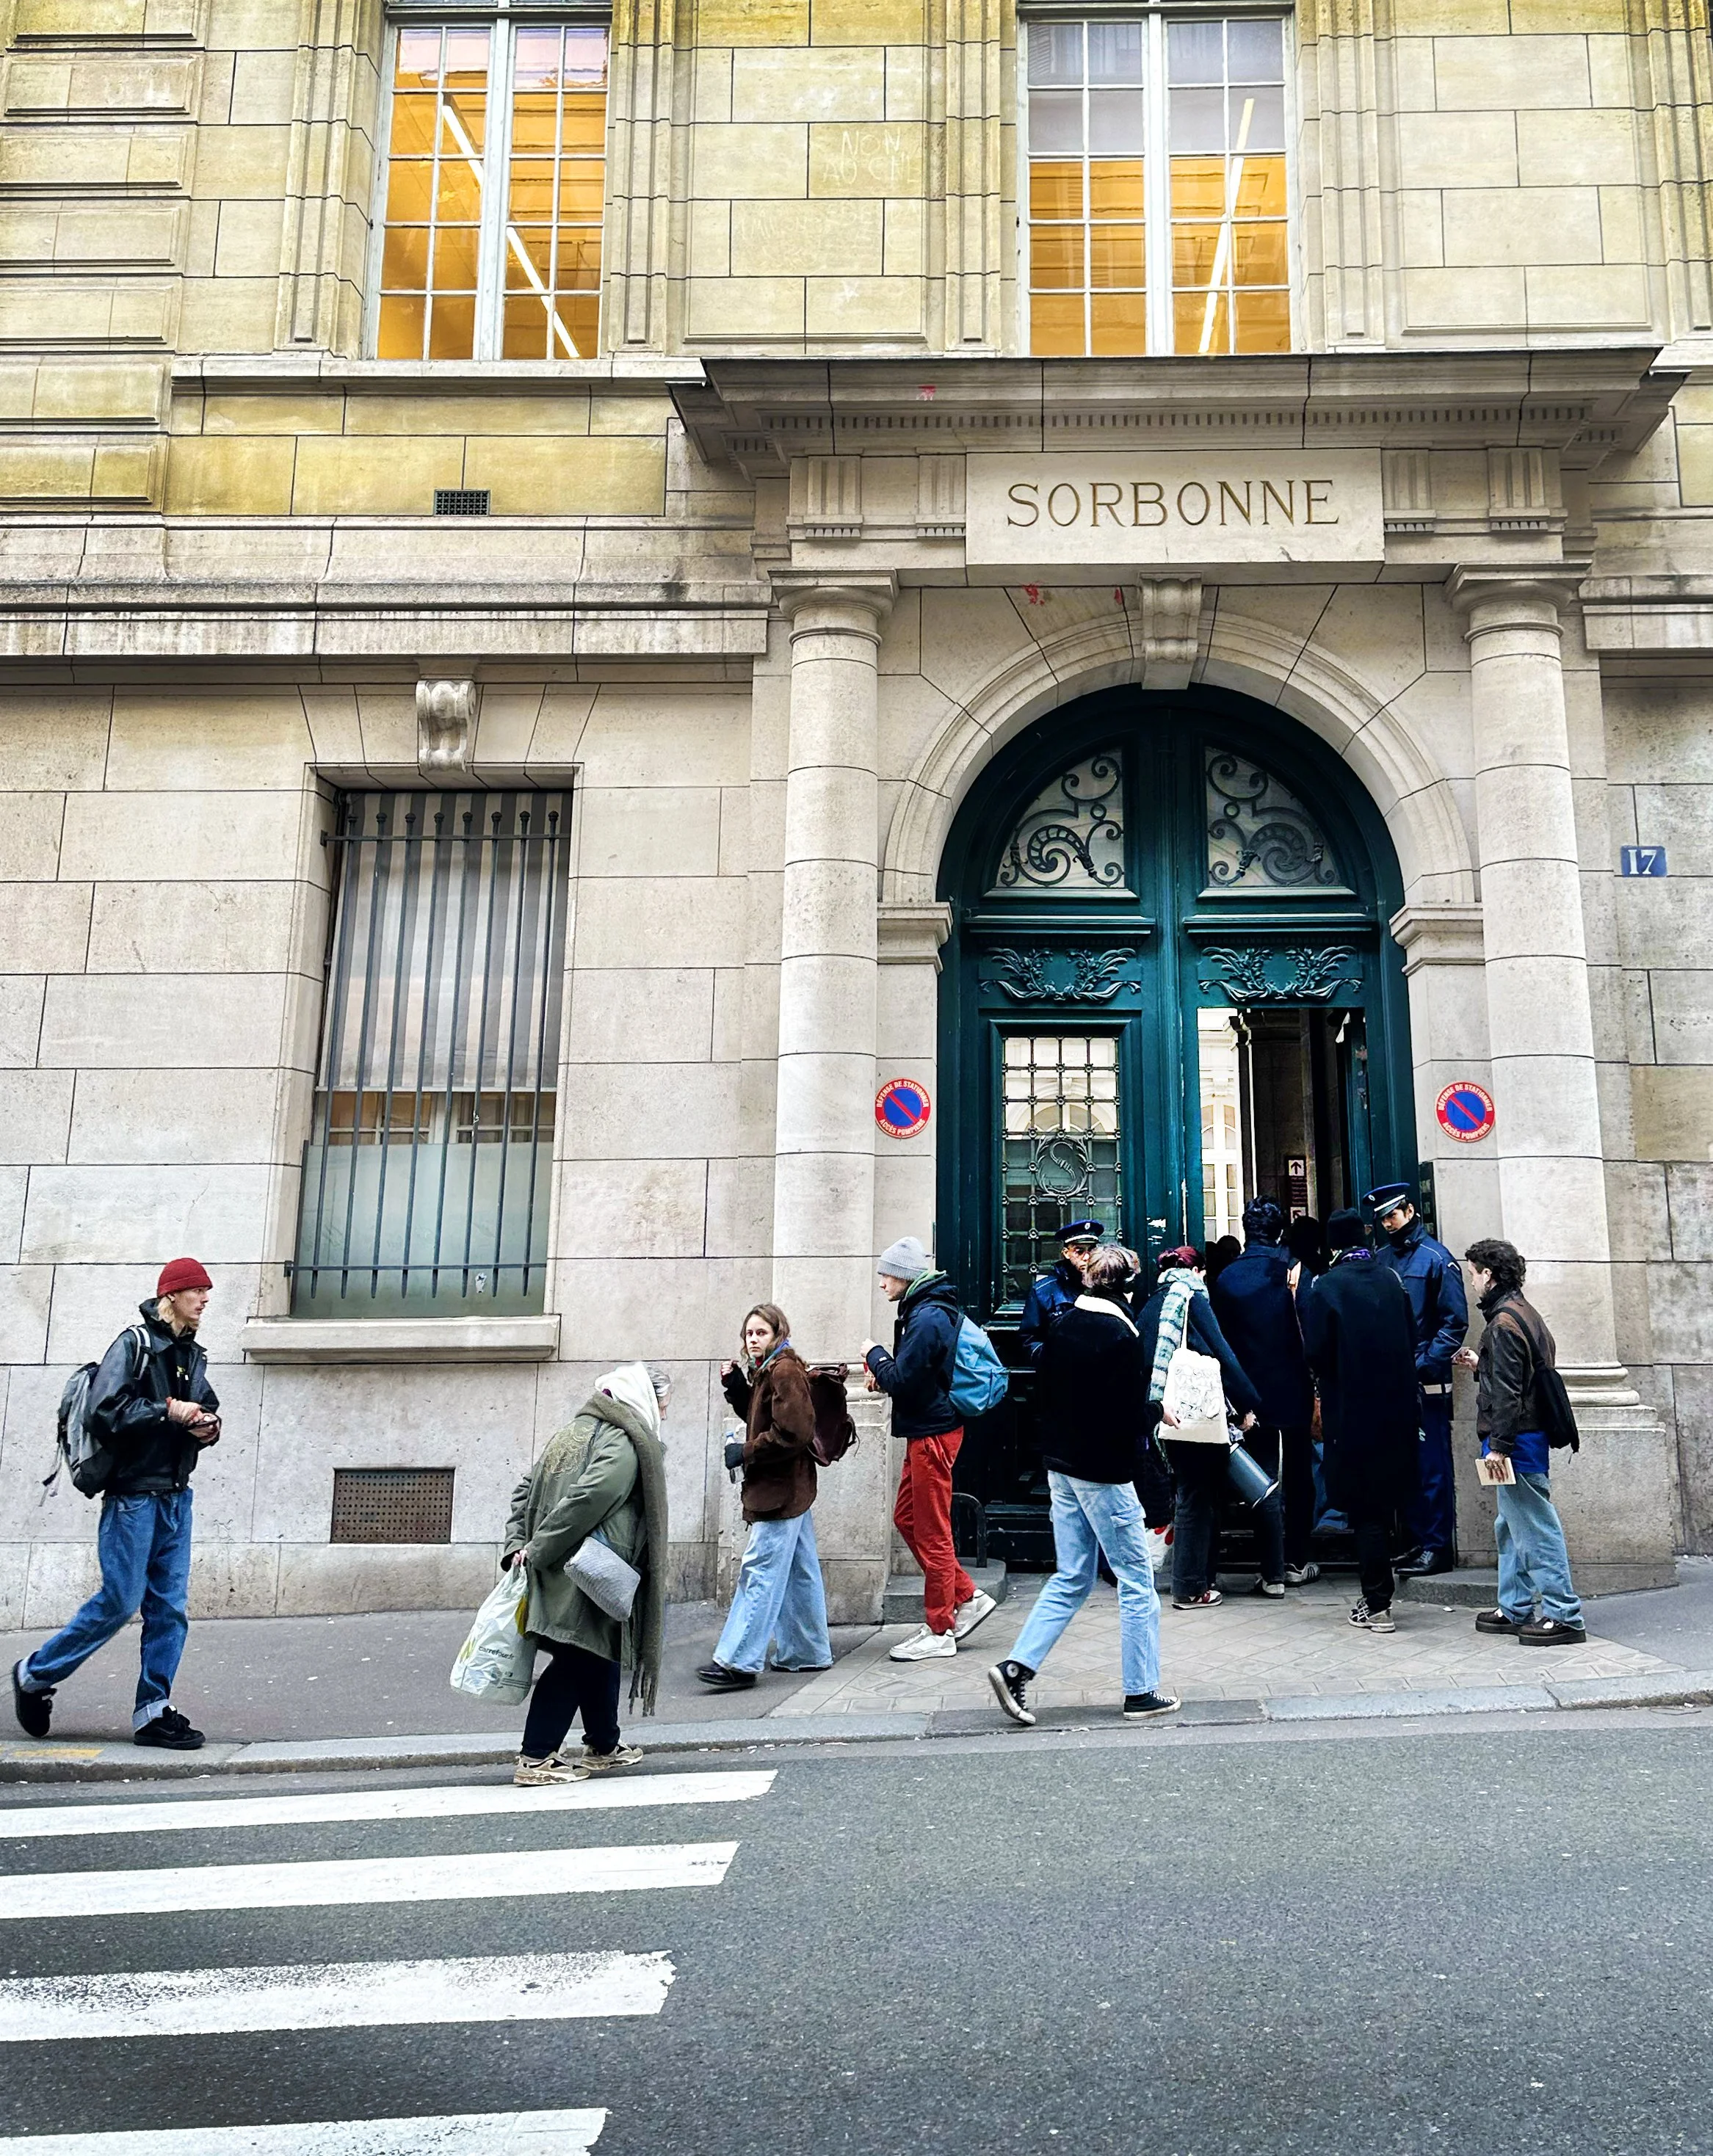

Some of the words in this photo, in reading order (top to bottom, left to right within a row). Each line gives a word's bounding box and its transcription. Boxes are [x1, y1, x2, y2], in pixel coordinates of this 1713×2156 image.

[841, 127, 902, 156] NON
[1007, 479, 1339, 527] SORBONNE
[1628, 849, 1657, 875] 17
[903, 1081, 930, 1108] STATIONNER
[1464, 1084, 1493, 1111] STATIONNER
[897, 1118, 926, 1135] POMPIERS
[1461, 1122, 1491, 1139] POMPIERS
[1049, 1141, 1076, 1194] S
